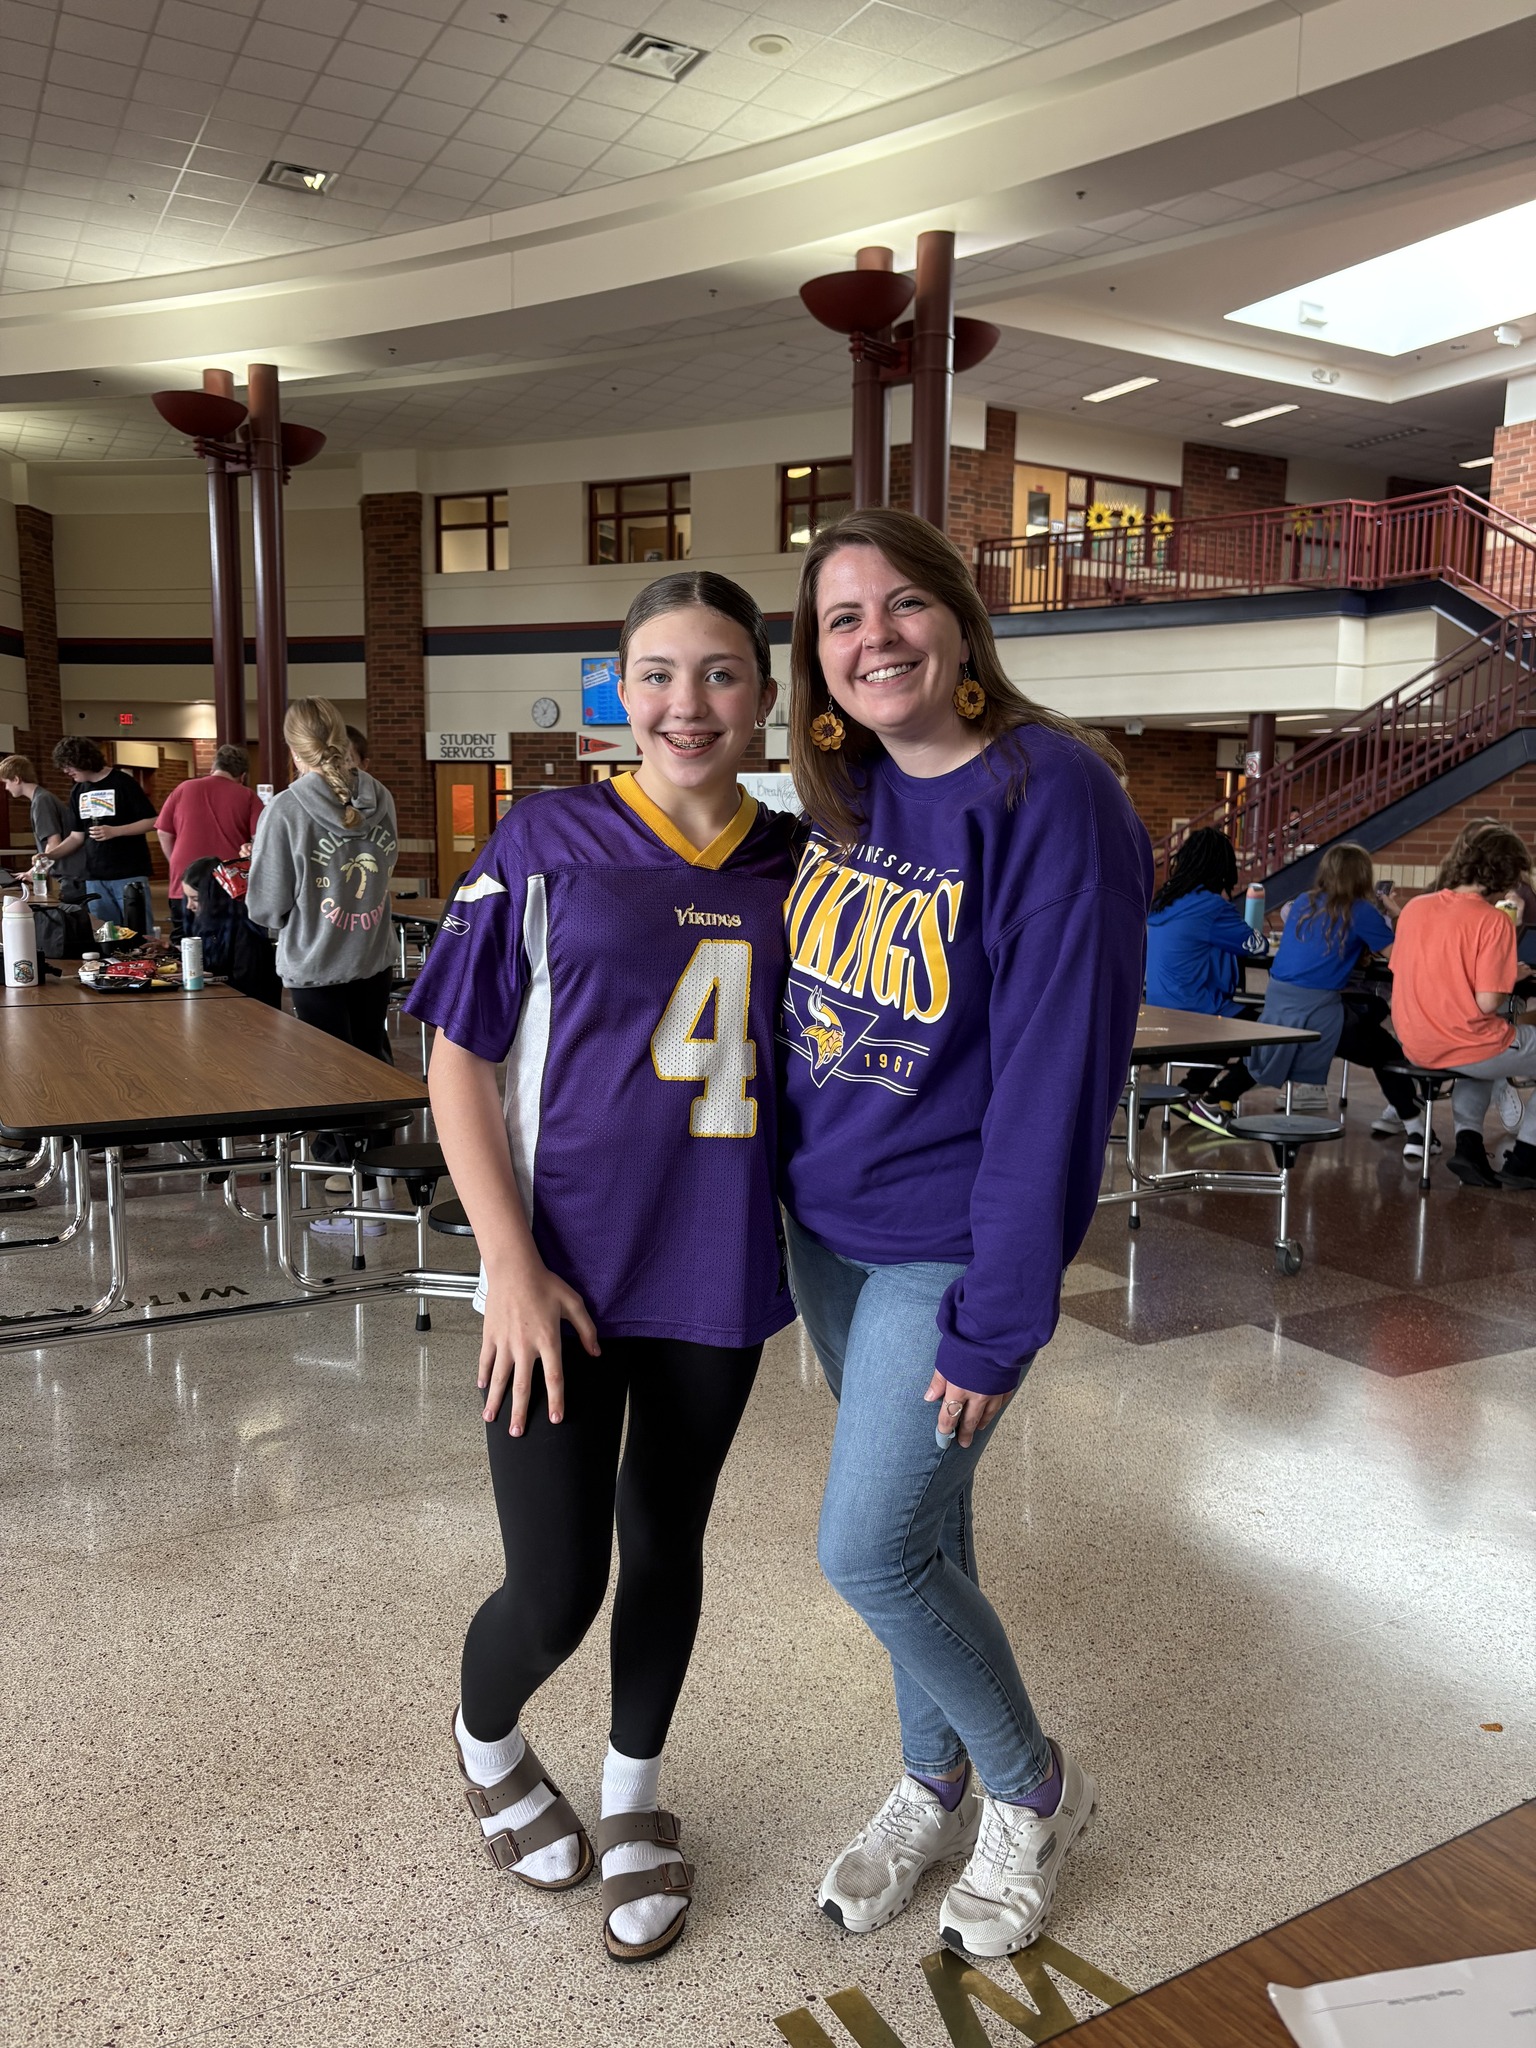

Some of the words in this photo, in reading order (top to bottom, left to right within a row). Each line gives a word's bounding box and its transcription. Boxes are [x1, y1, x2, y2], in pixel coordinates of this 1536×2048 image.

[440, 733, 497, 745] STUDENT
[440, 746, 495, 758] SERVICES
[310, 825, 396, 867] HOLTER
[315, 877, 331, 888] 20
[320, 889, 389, 932] CALIFOR
[782, 840, 965, 1024] VIKINGS
[650, 938, 758, 1138] 4
[864, 1052, 914, 1078] 1961
